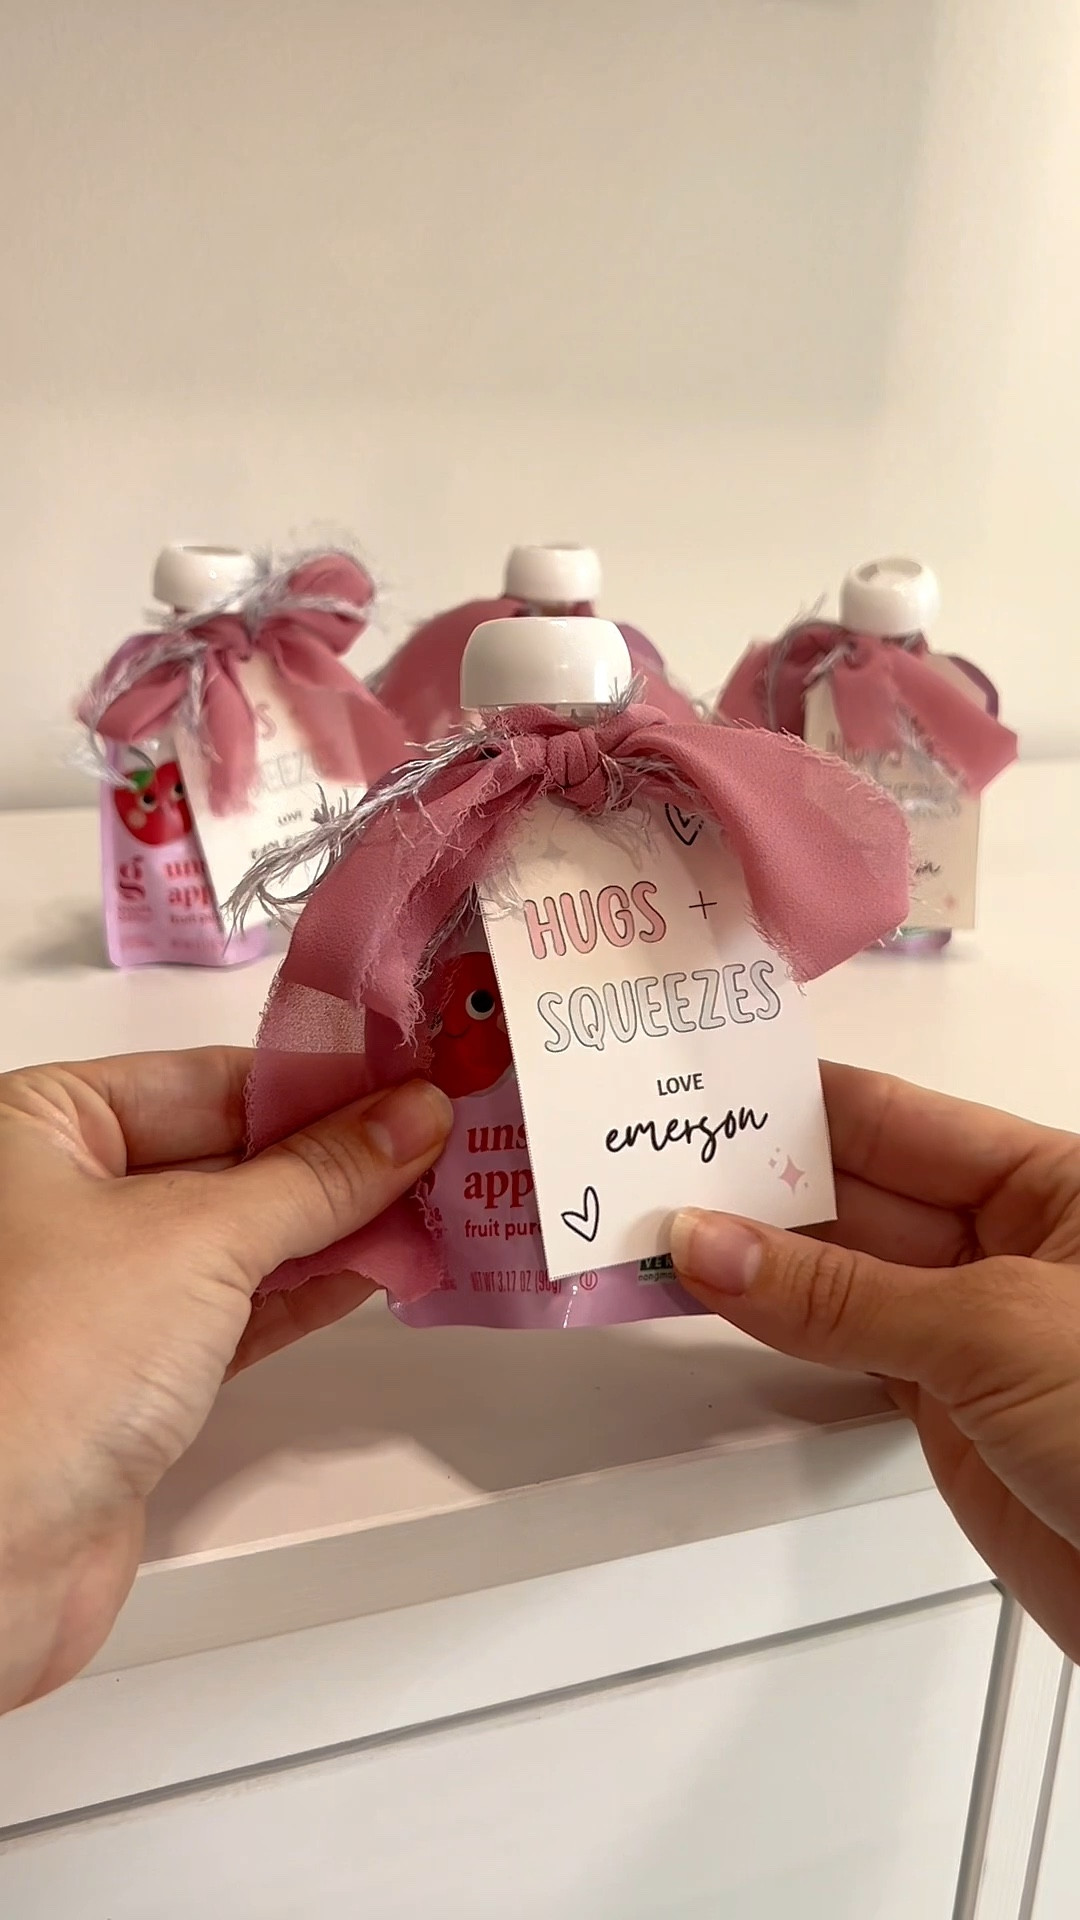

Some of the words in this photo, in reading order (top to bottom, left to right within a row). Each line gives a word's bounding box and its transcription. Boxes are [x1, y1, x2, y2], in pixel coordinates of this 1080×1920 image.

[523, 881, 667, 959] HUGS
[688, 890, 718, 920] +
[537, 960, 781, 1053] SQUEEZES
[657, 1073, 705, 1096] LOVE
[605, 1106, 769, 1163] emerson
[463, 1168, 535, 1209] app
[465, 1218, 500, 1238] fruit
[504, 1221, 542, 1241] pur
[498, 1270, 517, 1293] 3.17
[520, 1270, 532, 1292] OZ
